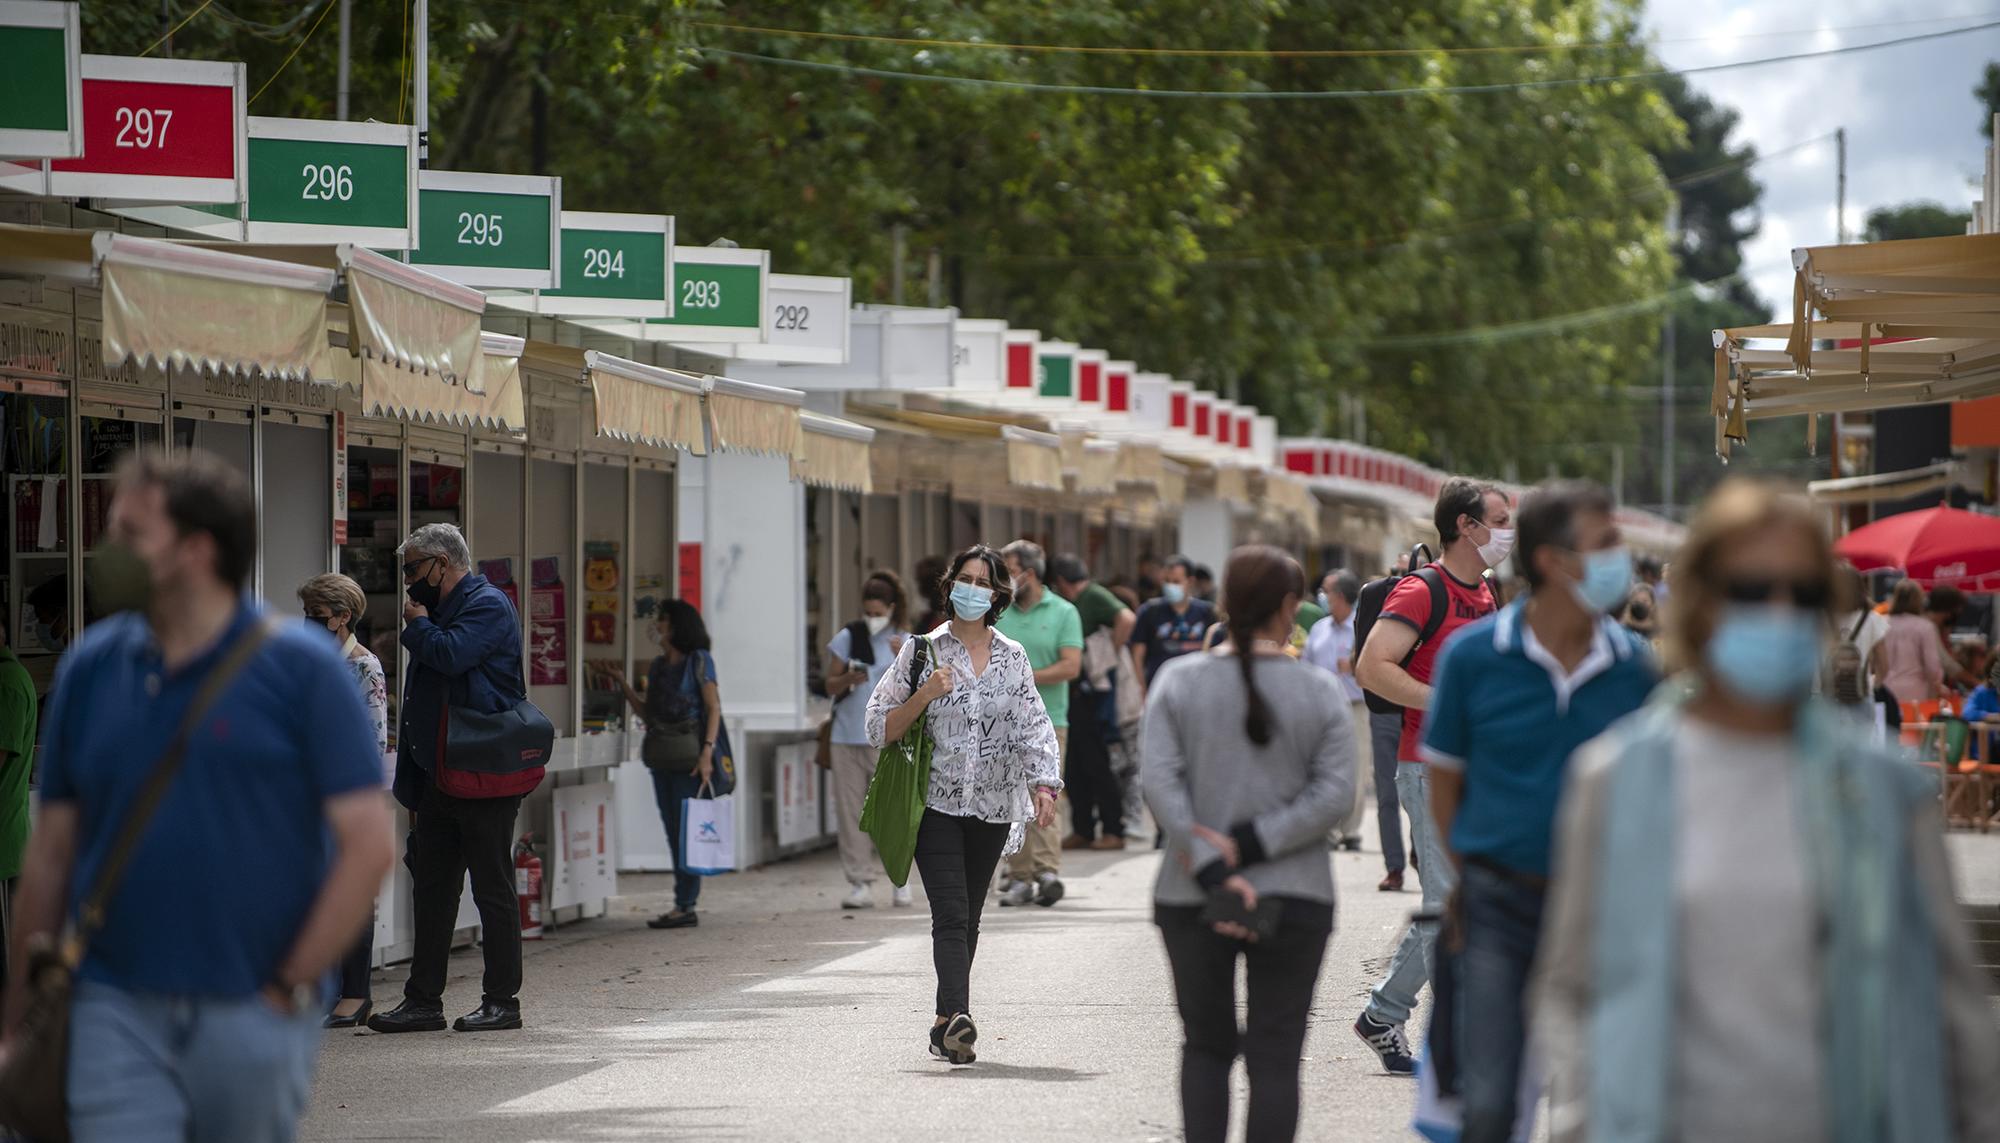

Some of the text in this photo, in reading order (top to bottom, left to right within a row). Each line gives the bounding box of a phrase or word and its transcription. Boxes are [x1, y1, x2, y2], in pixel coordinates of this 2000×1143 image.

[115, 107, 173, 149] 297
[301, 164, 353, 201] 296
[457, 212, 504, 246] 295
[583, 248, 625, 279] 294
[681, 279, 721, 309] 293
[774, 304, 809, 331] 292
